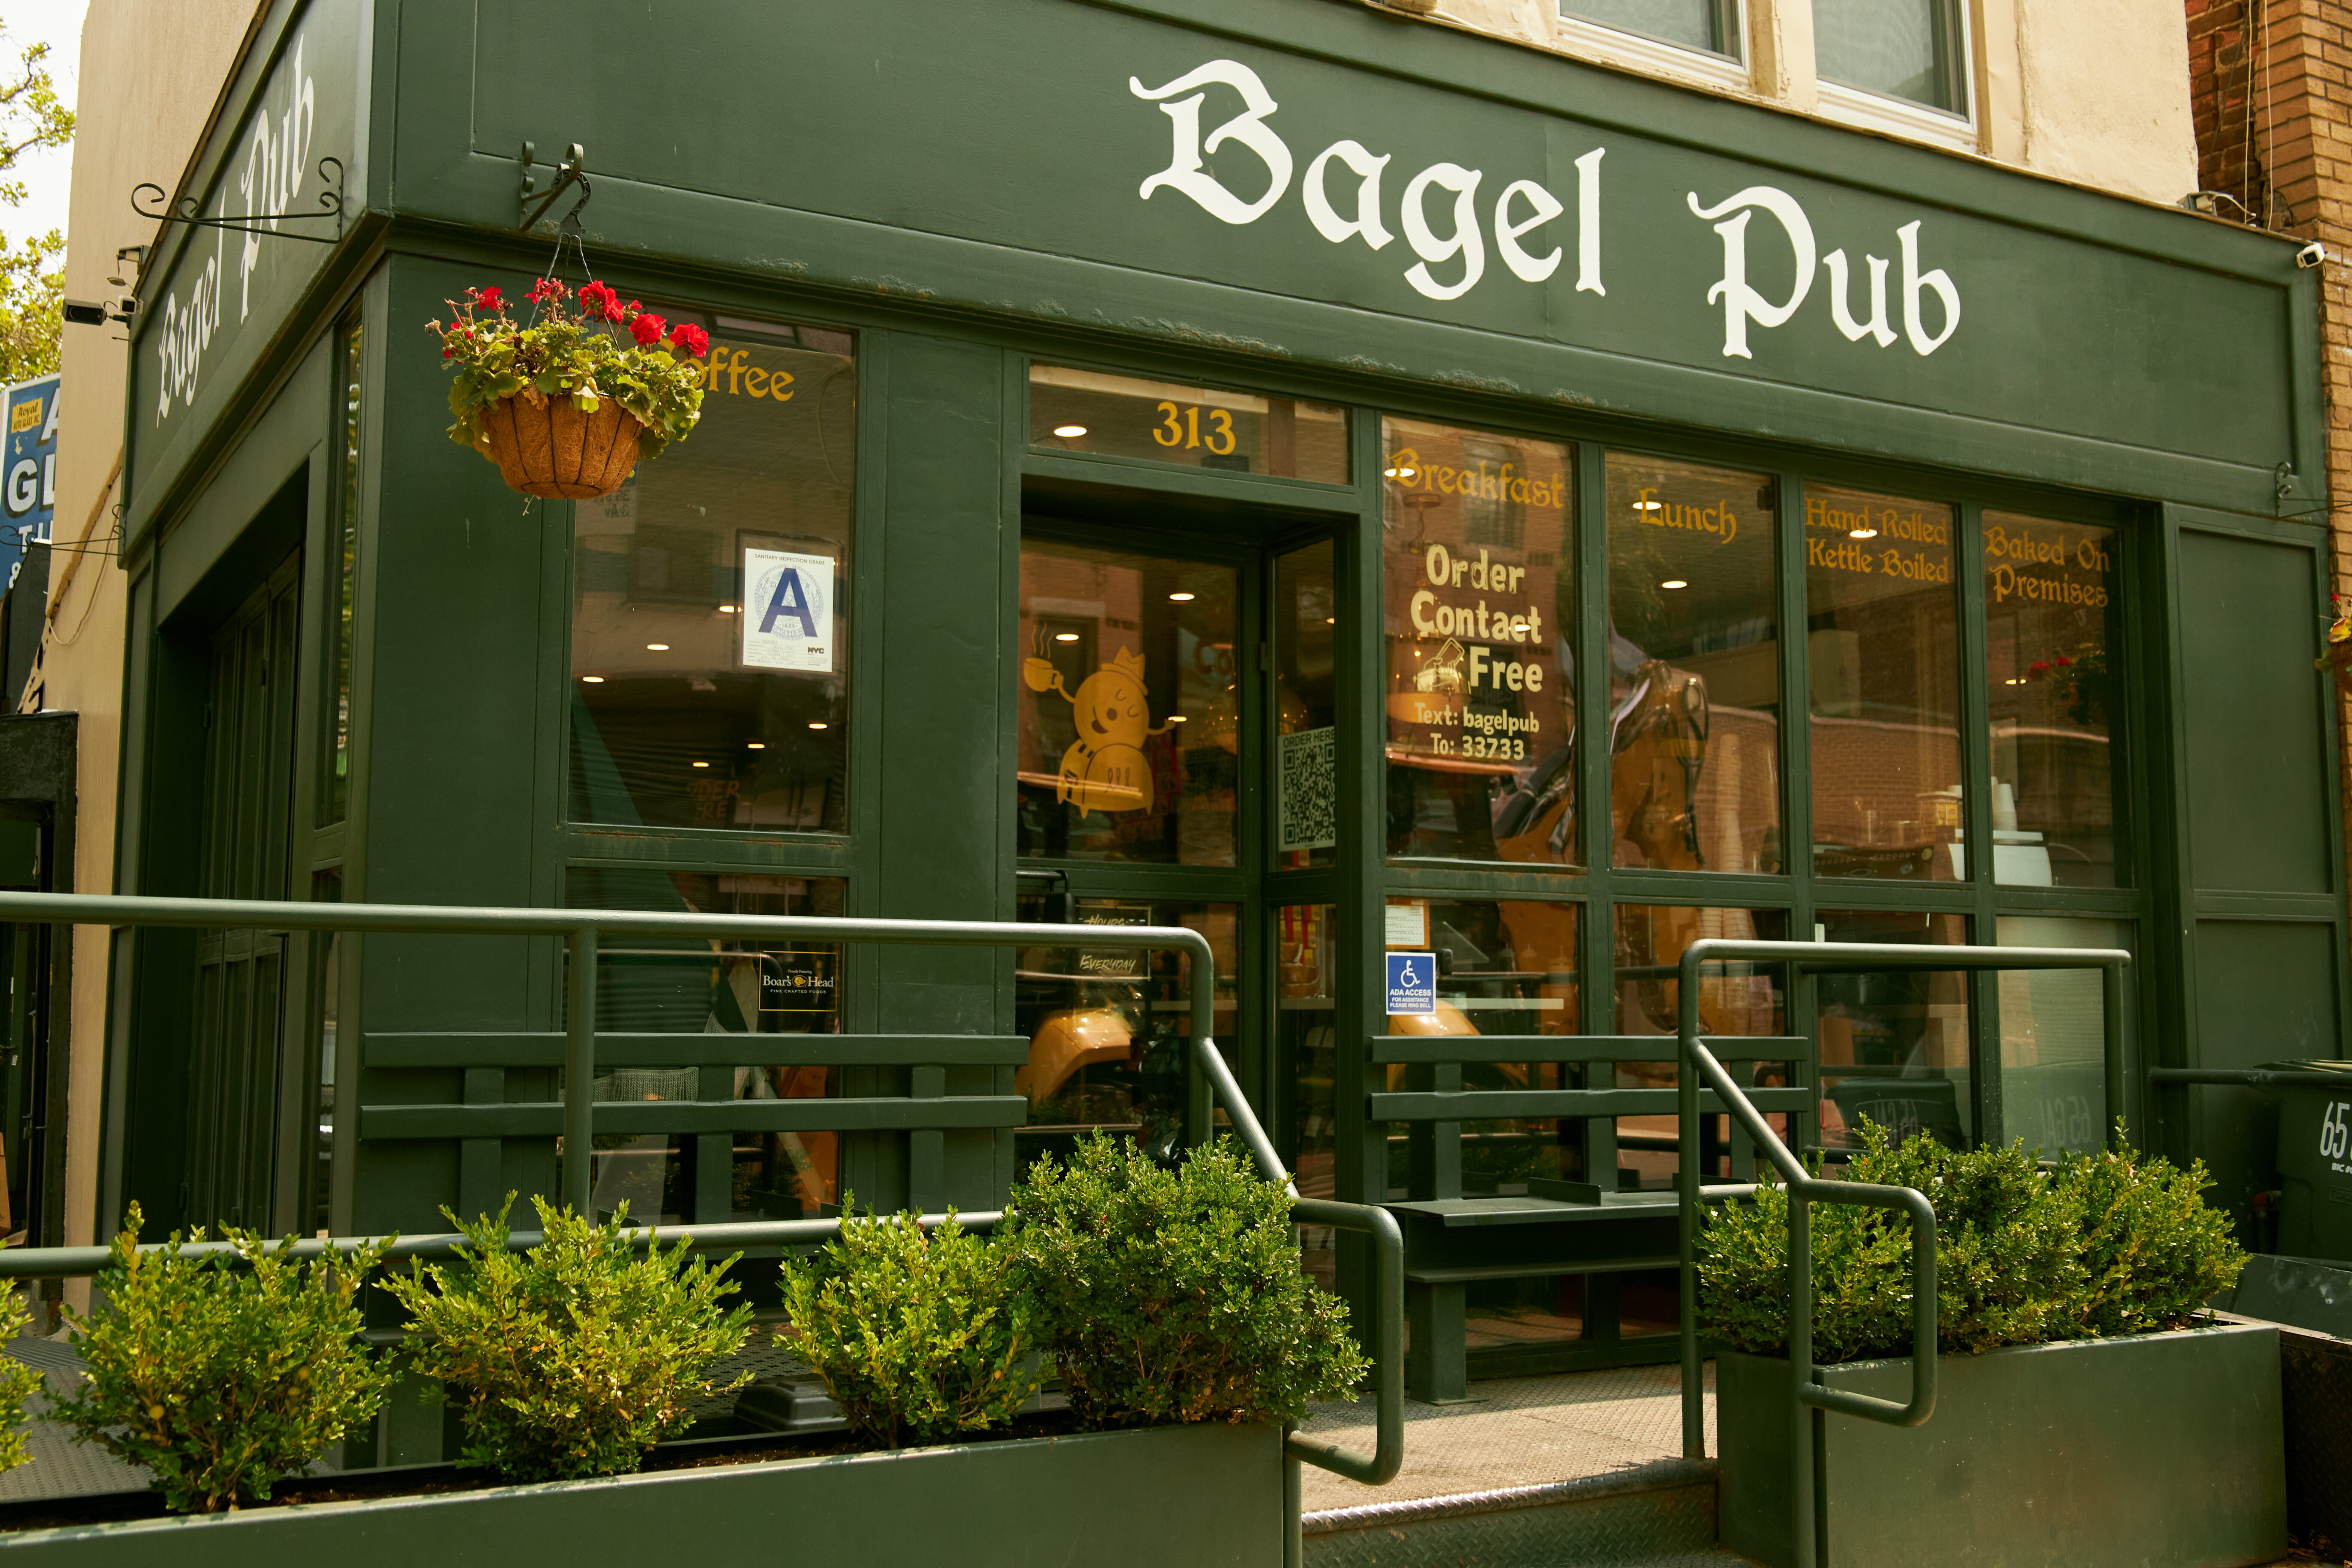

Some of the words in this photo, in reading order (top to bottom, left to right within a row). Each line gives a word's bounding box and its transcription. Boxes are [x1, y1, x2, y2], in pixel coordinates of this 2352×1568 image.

[157, 186, 226, 428] Bagel
[241, 33, 314, 325] Pub
[1129, 59, 1605, 300] Bagel
[1687, 186, 1960, 359] Pub
[18, 401, 38, 417] Royal
[22, 416, 33, 427] GLASS
[1153, 401, 1236, 455] 313
[1385, 448, 1564, 509] Breakfast
[1638, 488, 1737, 544] Lunch
[1806, 497, 1869, 532] Hand
[1877, 509, 1947, 545] Rolled
[1426, 544, 1525, 594] Order
[1806, 538, 1872, 573] Kettle
[1879, 549, 1949, 583] Boiled
[1983, 526, 2065, 566] Baked
[2078, 539, 2110, 572] On
[758, 567, 818, 638] A
[1989, 564, 2109, 608] Premises
[1411, 590, 1542, 644] Contact
[1470, 646, 1543, 692] Free
[1283, 733, 1311, 748] ORDER
[1314, 729, 1335, 743] HERE
[1414, 702, 1458, 726] Text:
[1463, 706, 1539, 736] bagelpub
[1430, 733, 1455, 755] To:
[1462, 735, 1524, 761] 33733
[763, 975, 792, 986] Boar's
[807, 976, 834, 987] Head
[2320, 1101, 2350, 1159] 65
[2331, 1162, 2345, 1173] BIC
